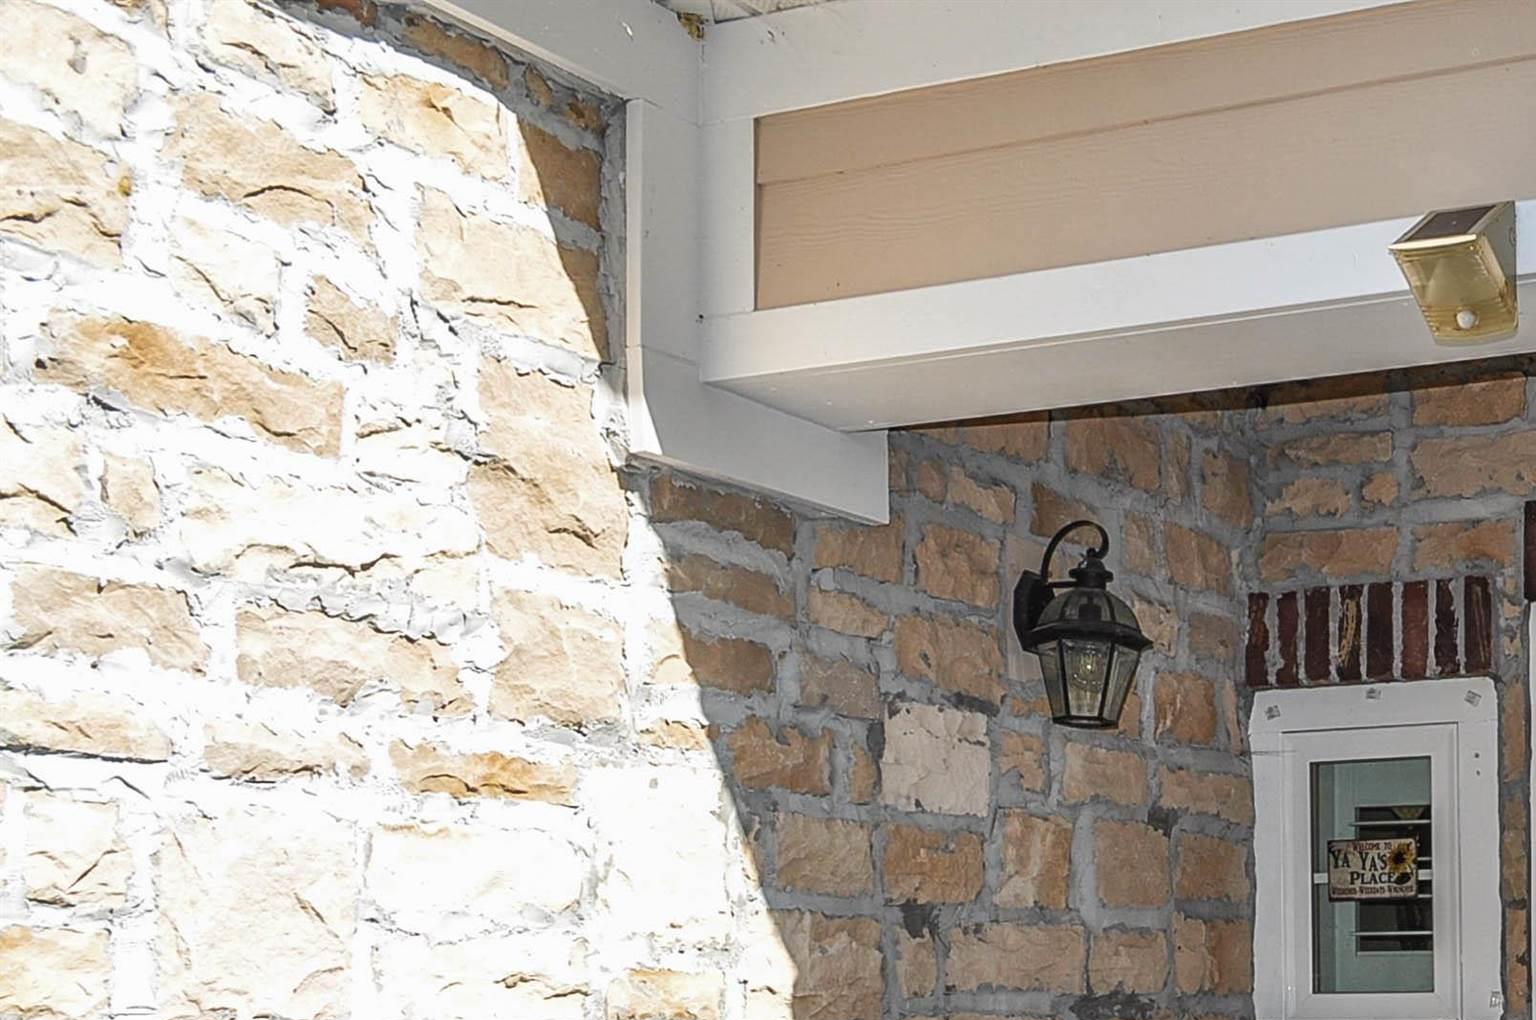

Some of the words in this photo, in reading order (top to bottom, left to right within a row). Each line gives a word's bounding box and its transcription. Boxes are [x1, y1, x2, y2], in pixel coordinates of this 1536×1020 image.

[1329, 849, 1351, 869] YA
[1358, 851, 1388, 872] YA'S
[1349, 870, 1396, 885] PLACE
